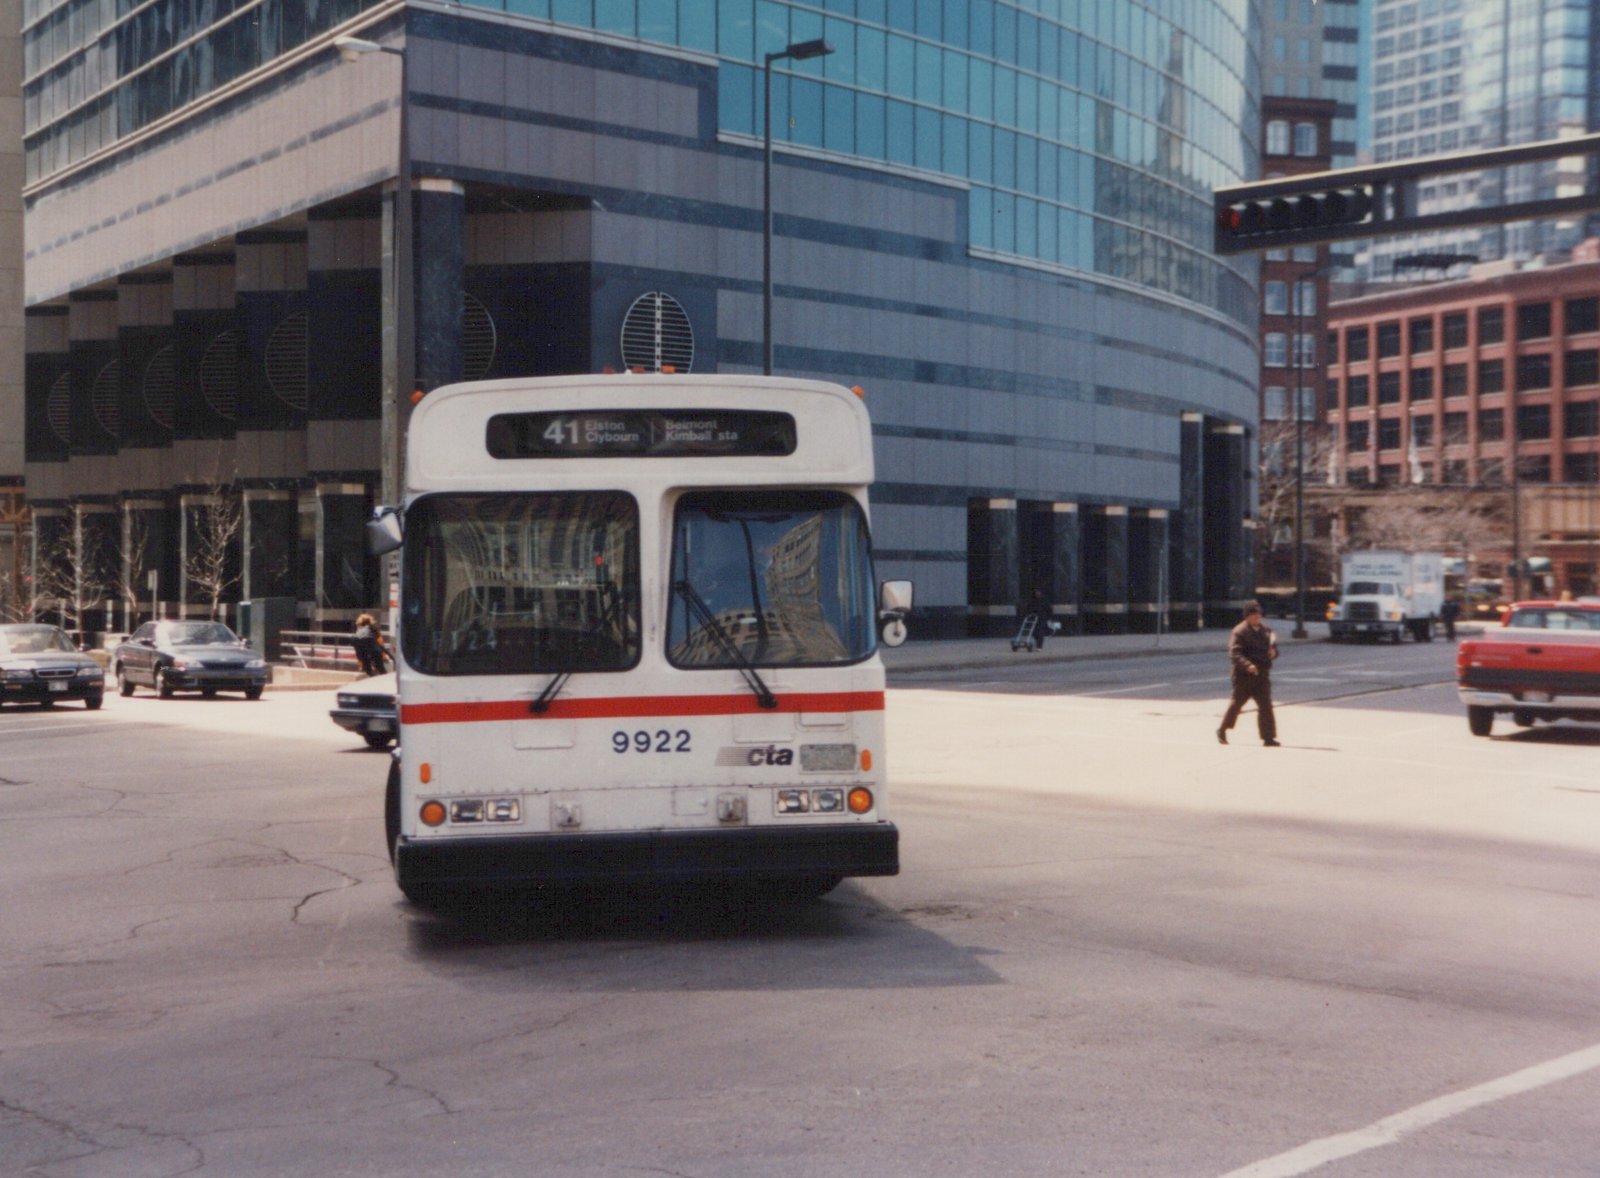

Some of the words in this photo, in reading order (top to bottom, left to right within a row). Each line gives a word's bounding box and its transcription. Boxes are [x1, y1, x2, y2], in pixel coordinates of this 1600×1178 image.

[543, 420, 579, 444] 41
[585, 420, 625, 431] Elston
[585, 431, 640, 443] Clybourn
[665, 430, 712, 441] Kimball
[718, 430, 738, 441] sta
[612, 729, 691, 754] 9922
[747, 744, 794, 766] cta
